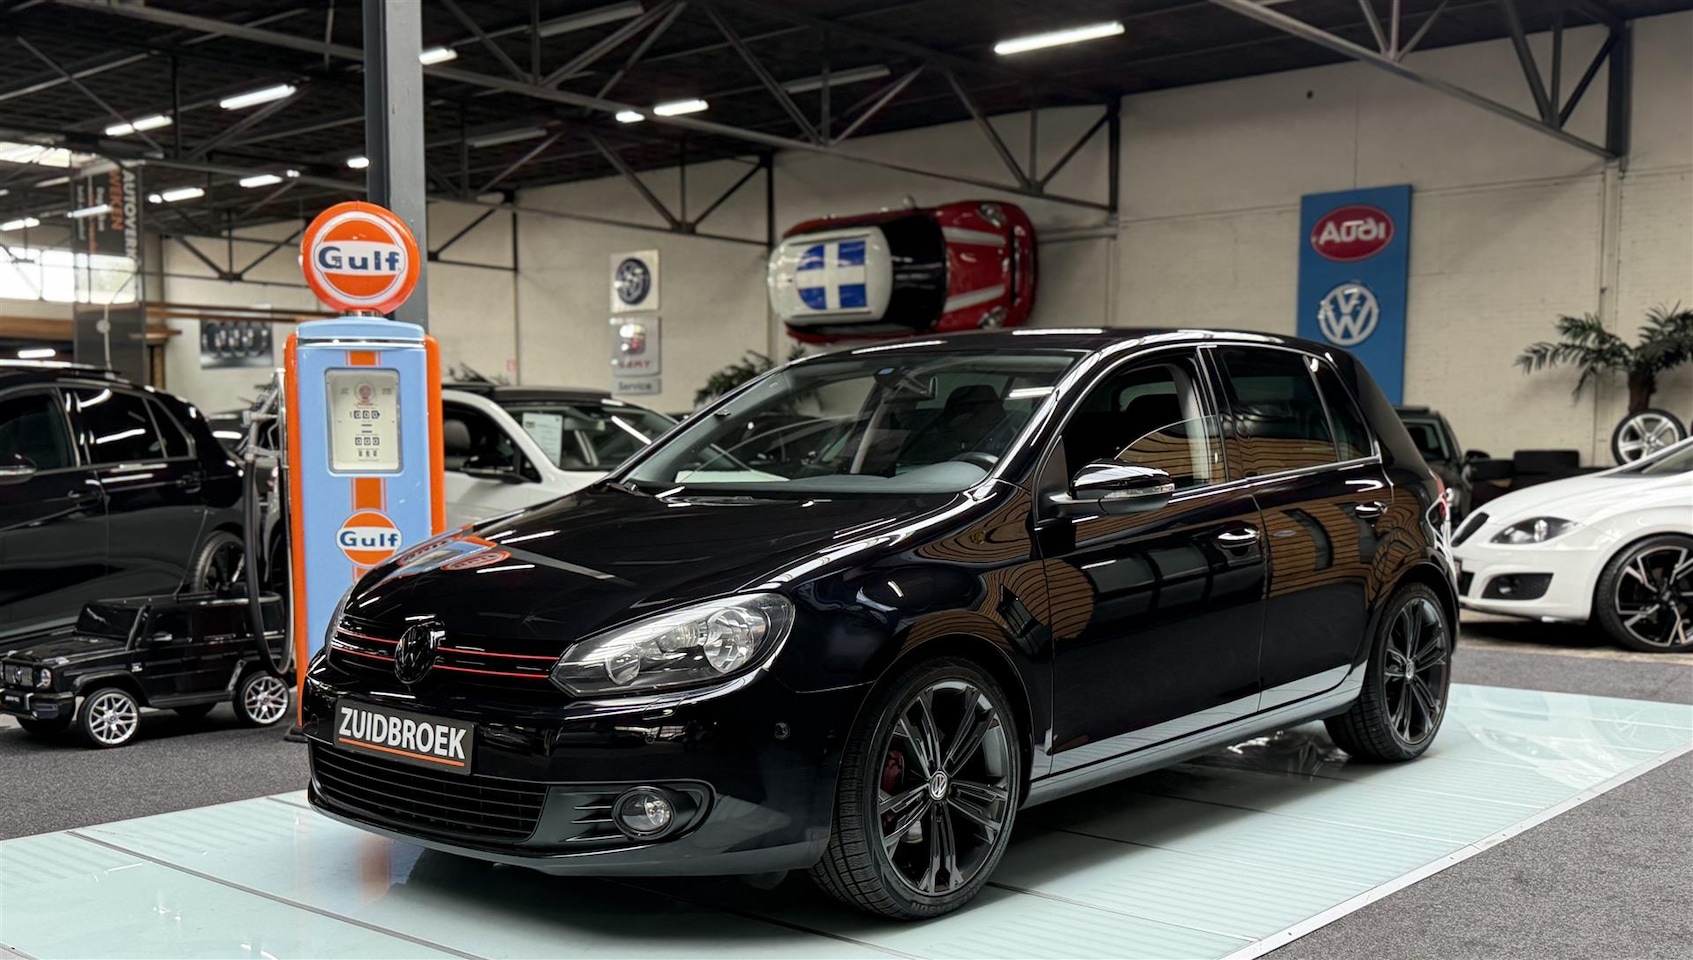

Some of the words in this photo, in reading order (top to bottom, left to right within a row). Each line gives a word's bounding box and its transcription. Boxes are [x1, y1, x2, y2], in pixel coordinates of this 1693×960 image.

[318, 245, 400, 271] Gulf
[619, 381, 652, 391] Service
[339, 530, 399, 547] Gulf
[338, 706, 467, 759] ZUIDBROEK
